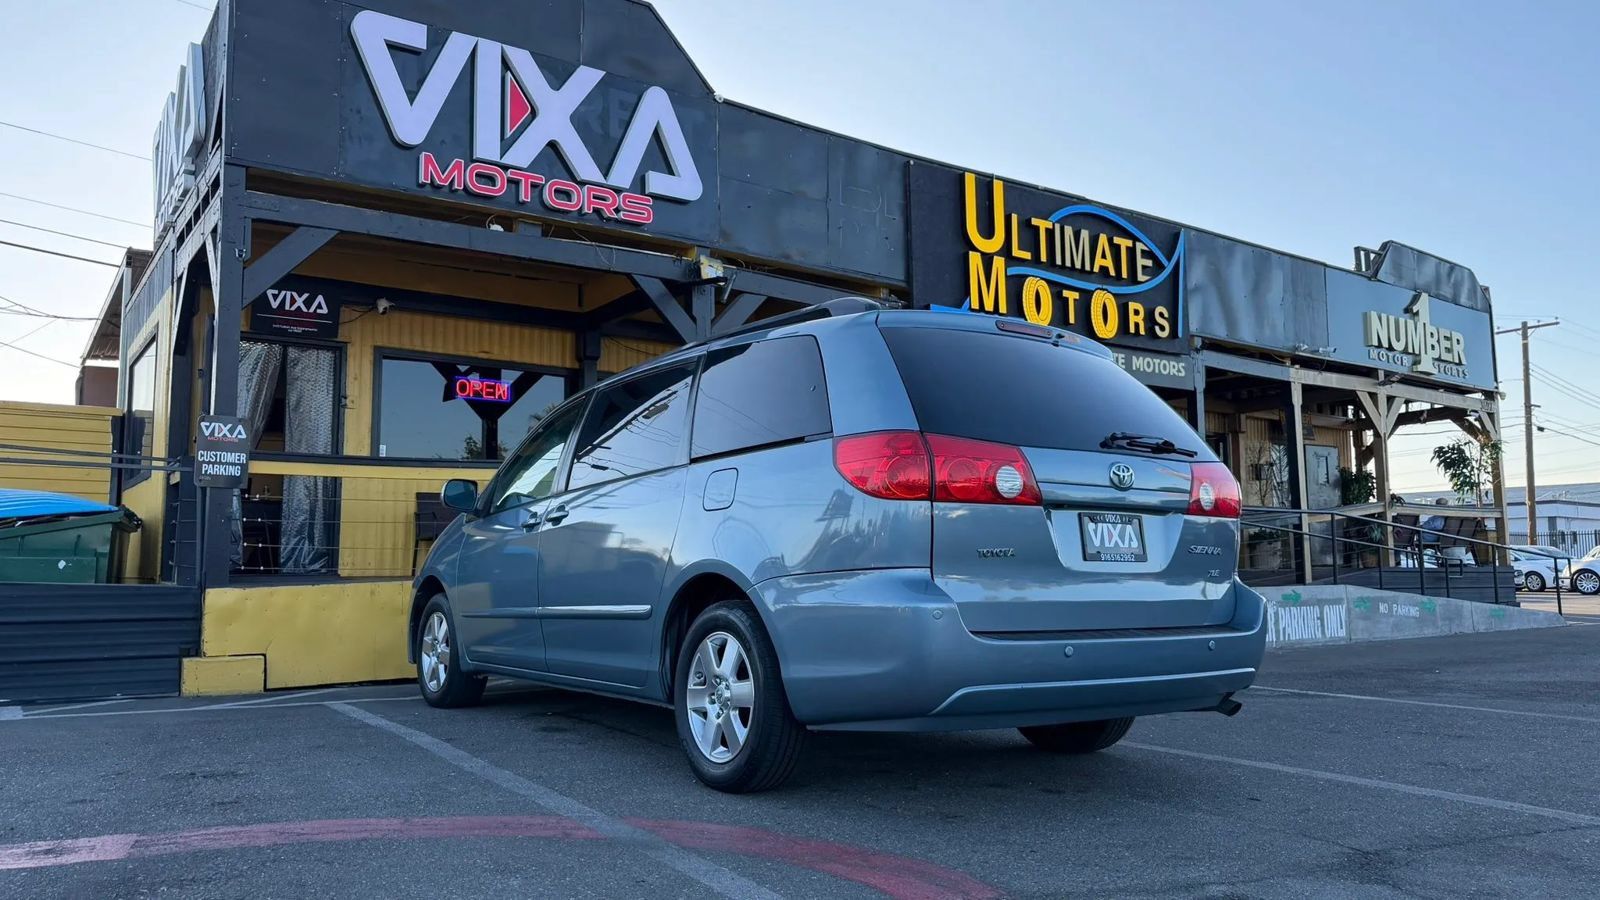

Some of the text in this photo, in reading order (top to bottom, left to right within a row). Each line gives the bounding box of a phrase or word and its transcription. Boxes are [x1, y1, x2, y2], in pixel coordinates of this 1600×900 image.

[350, 10, 703, 201] VIXA
[420, 152, 653, 224] MOTORS
[964, 171, 1153, 282] ULTIMATE
[266, 288, 328, 314] VIXA
[968, 251, 1170, 339] MOTORS
[1366, 310, 1467, 365] NUMBER
[1132, 355, 1186, 377] MOTORS
[1368, 348, 1409, 368] MOTOR
[456, 379, 508, 400] OPEN
[200, 421, 247, 438] VIXA
[198, 450, 247, 464] CUSTOMER
[202, 463, 241, 477] PARKING
[1087, 522, 1139, 548] VIXA
[976, 547, 1016, 559] TOYOTA
[1188, 545, 1222, 556] SIENNA
[1379, 602, 1420, 617] NO PARKING
[1278, 606, 1321, 641] PARKING
[1323, 605, 1346, 638] ONLY
